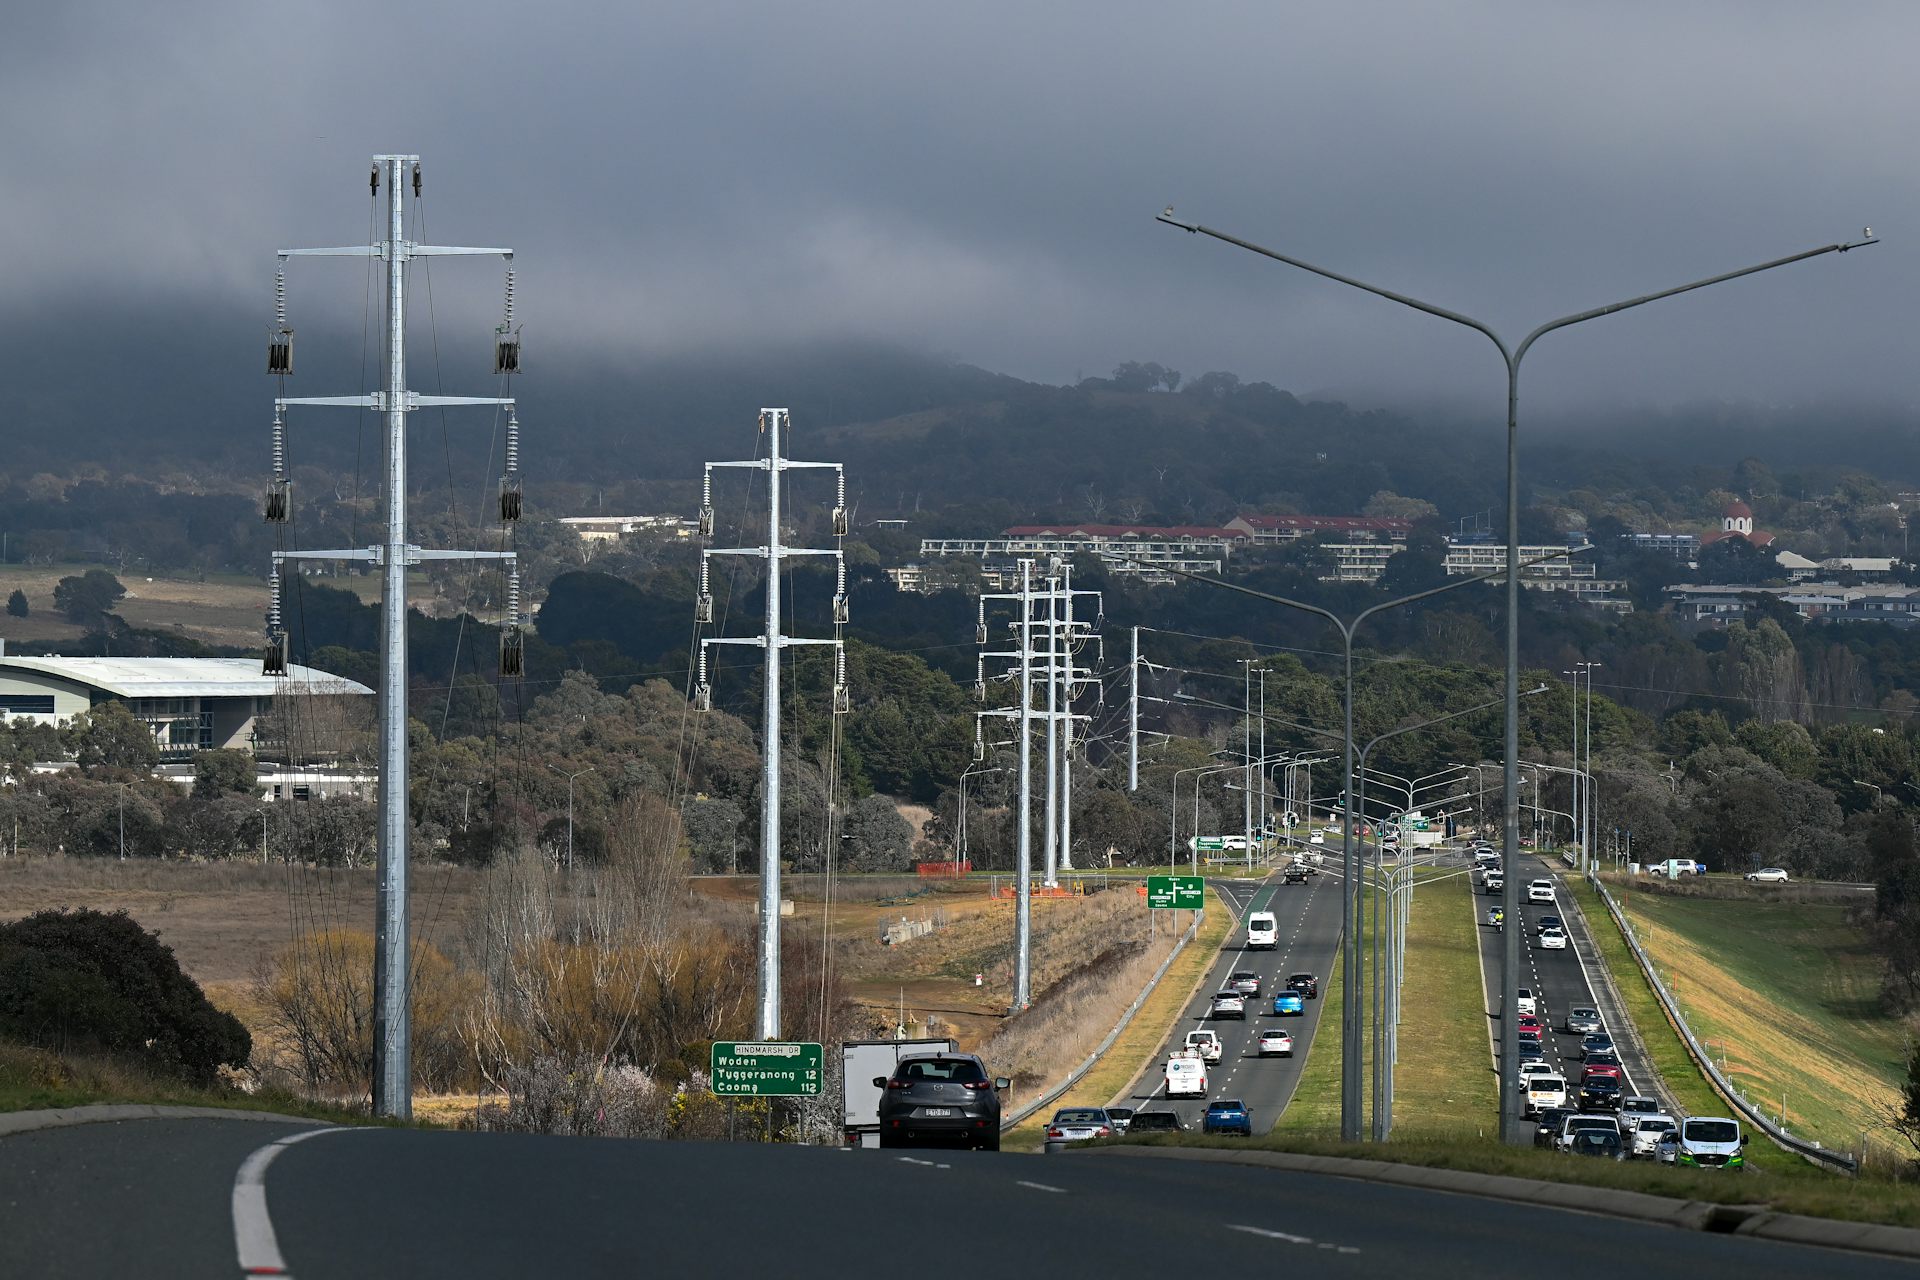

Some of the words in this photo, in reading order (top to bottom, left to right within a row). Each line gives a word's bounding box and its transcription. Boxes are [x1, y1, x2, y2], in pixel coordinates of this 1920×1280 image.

[735, 1046, 783, 1054] HINDMARSH
[718, 1056, 757, 1066] Woden
[809, 1057, 817, 1066] 7
[718, 1068, 795, 1081] Tuggeranong
[804, 1070, 817, 1080] 12
[718, 1082, 758, 1092] Cooma
[800, 1083, 817, 1093] 112
